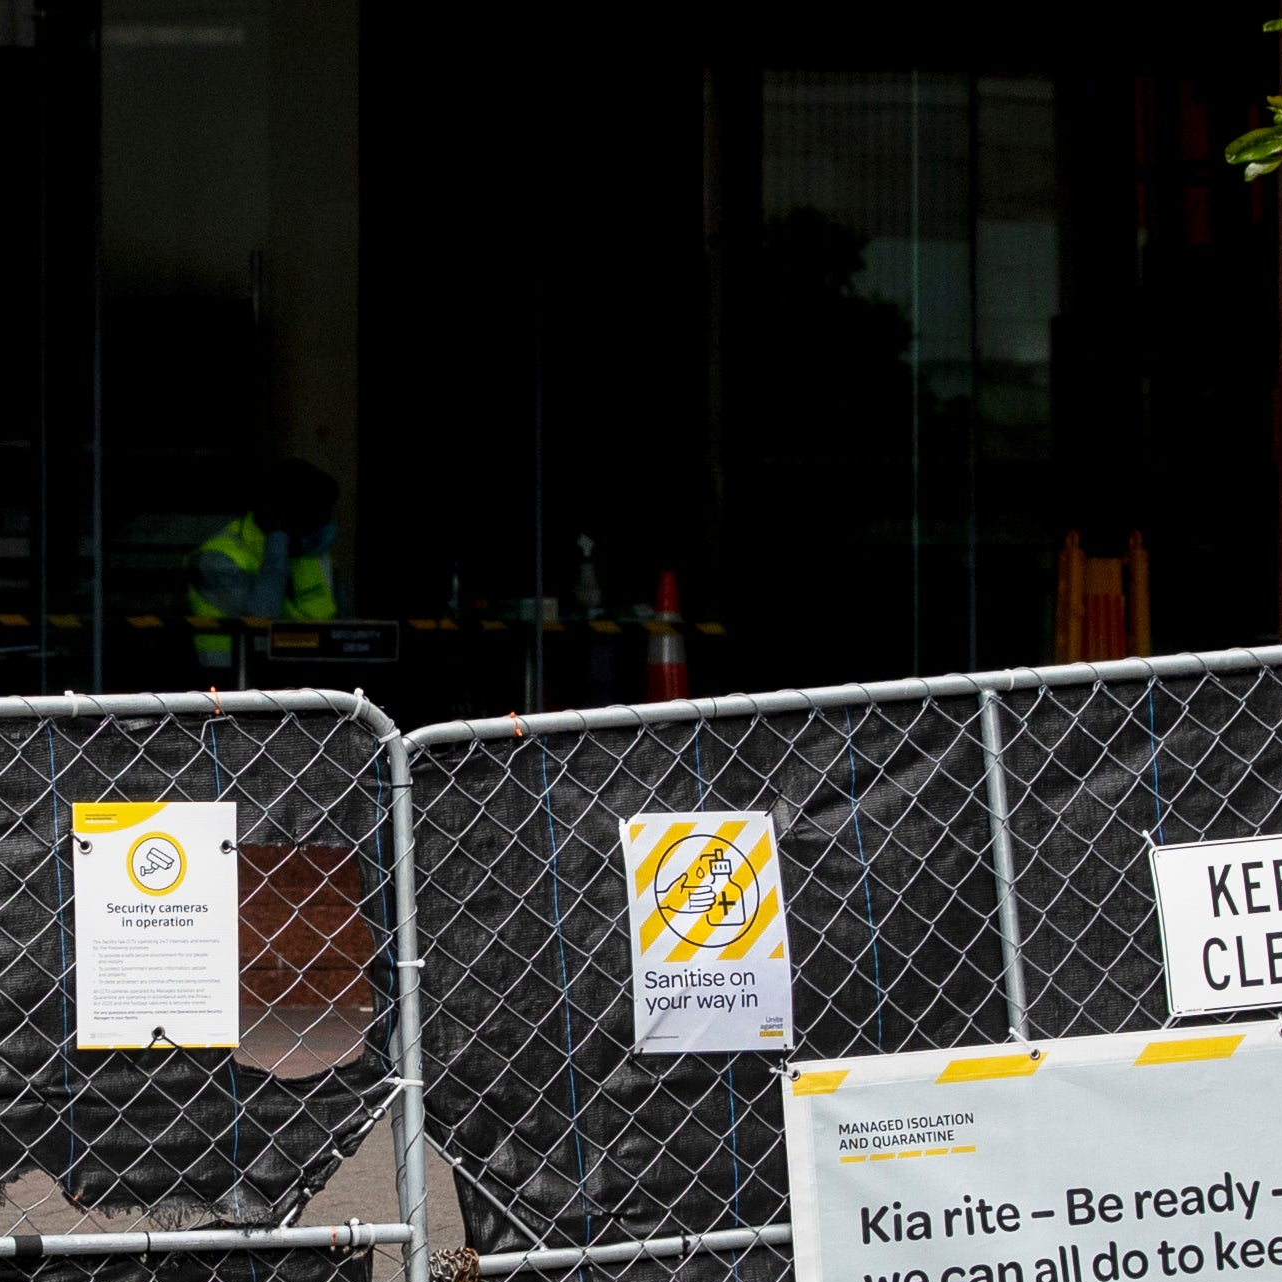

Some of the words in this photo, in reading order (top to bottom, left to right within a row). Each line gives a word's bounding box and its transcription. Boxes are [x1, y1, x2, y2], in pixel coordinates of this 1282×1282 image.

[107, 903, 155, 915] Security
[159, 904, 208, 913] cameras
[122, 917, 133, 928] in
[136, 917, 194, 928] operation
[645, 969, 725, 989] Sanitise
[730, 970, 755, 986] on
[645, 995, 691, 1015] your
[696, 993, 737, 1012] way
[741, 989, 758, 1008] in
[839, 1119, 903, 1135] MANAGED
[907, 1113, 973, 1129] ISOLATION
[840, 1138, 868, 1150] AND
[873, 1130, 954, 1149] QUARANTINE
[861, 1202, 932, 1244] Kia
[944, 1195, 1020, 1237] rite
[1067, 1188, 1123, 1225] Be
[1135, 1172, 1260, 1220] ready
[1093, 1241, 1148, 1282] do
[1157, 1241, 1204, 1276] to
